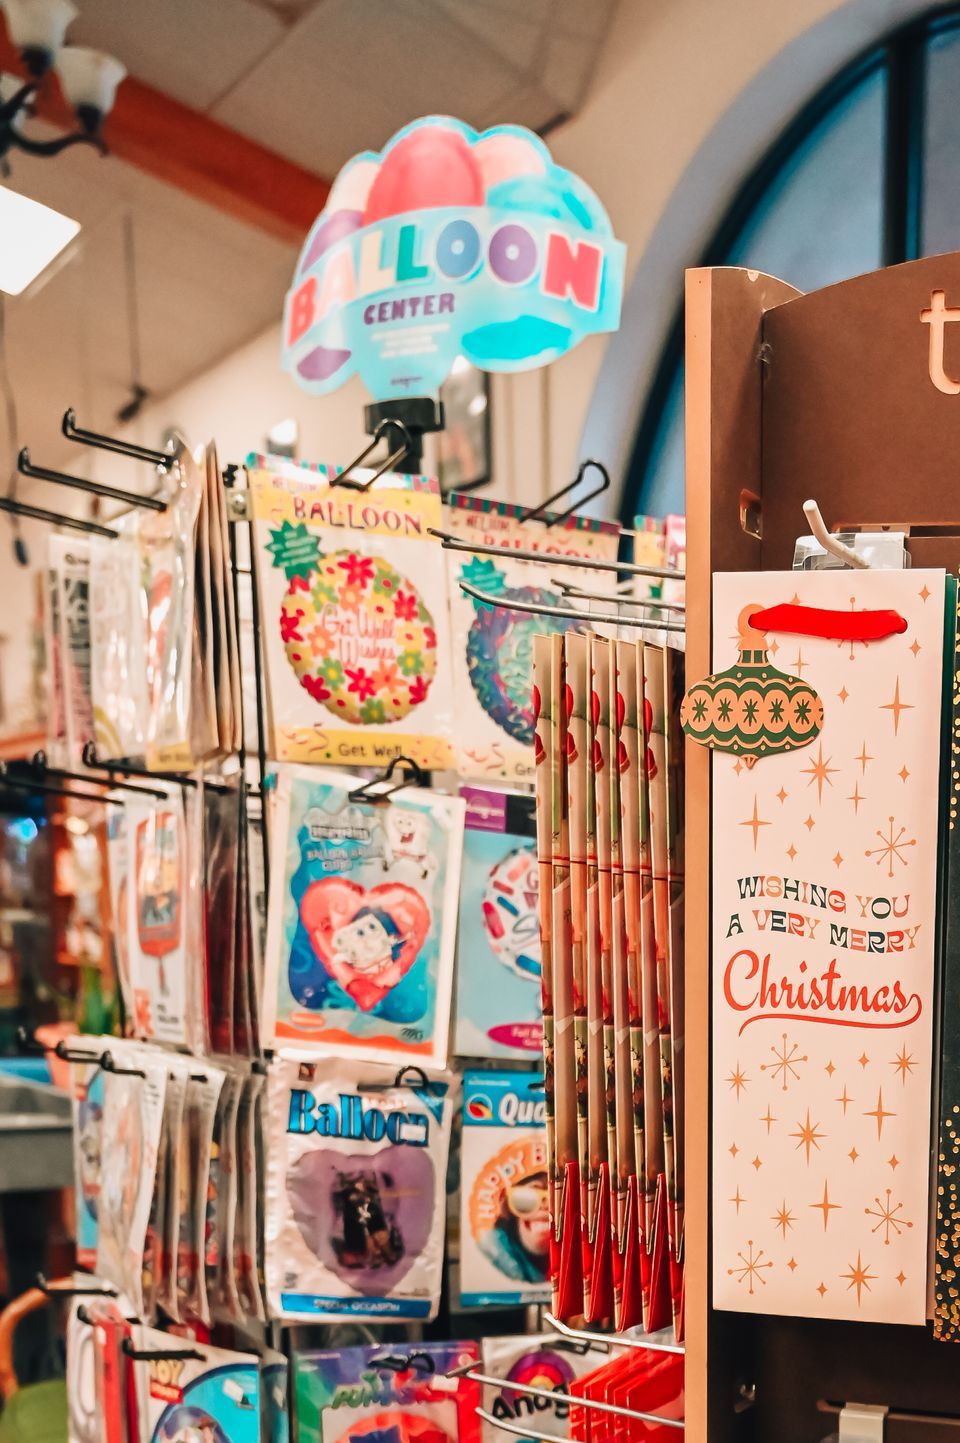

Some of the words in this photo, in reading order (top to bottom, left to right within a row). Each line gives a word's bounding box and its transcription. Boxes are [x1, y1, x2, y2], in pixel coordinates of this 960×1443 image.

[288, 219, 602, 347] BALLOON
[364, 293, 456, 325] CENTER
[294, 496, 422, 535] BALLOON
[338, 743, 366, 757] Get
[737, 875, 846, 914] WISHING
[855, 894, 910, 920] YOU
[726, 913, 744, 938] A
[752, 909, 821, 940] VERY
[830, 924, 922, 954] MERRY
[723, 949, 923, 1037] Christmas
[492, 1384, 571, 1421] Anag
